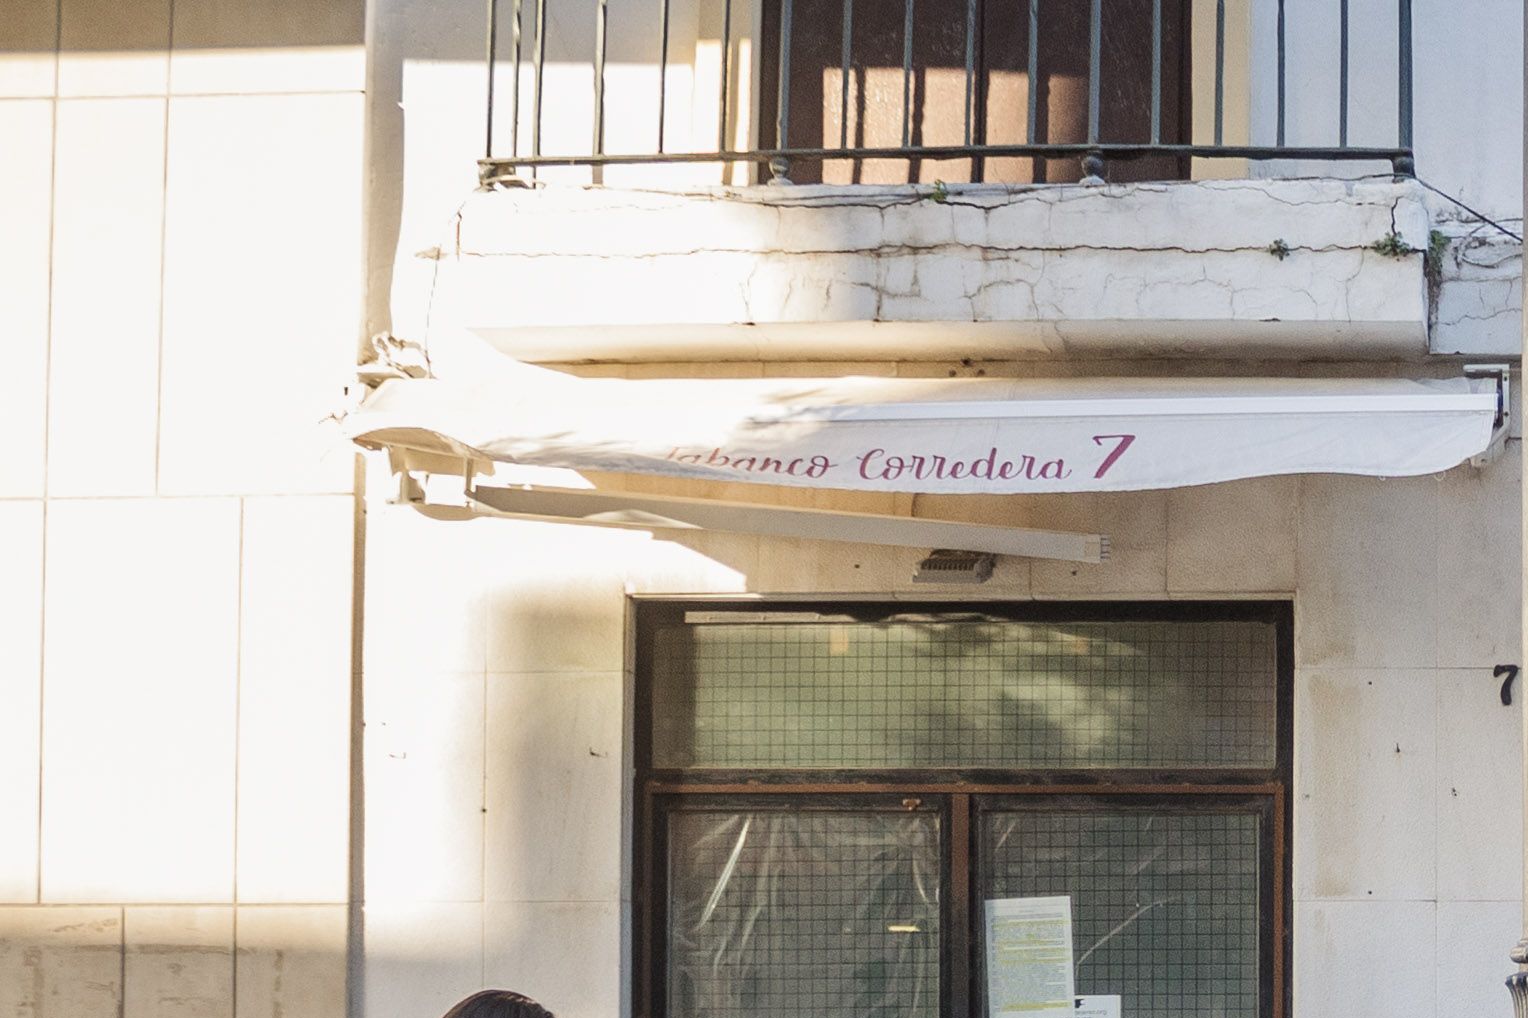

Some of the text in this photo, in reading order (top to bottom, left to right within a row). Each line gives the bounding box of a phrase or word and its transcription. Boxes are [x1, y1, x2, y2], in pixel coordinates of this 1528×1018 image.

[857, 448, 1072, 480] Corredera
[1092, 434, 1136, 479] 7
[1493, 664, 1518, 706] 7
